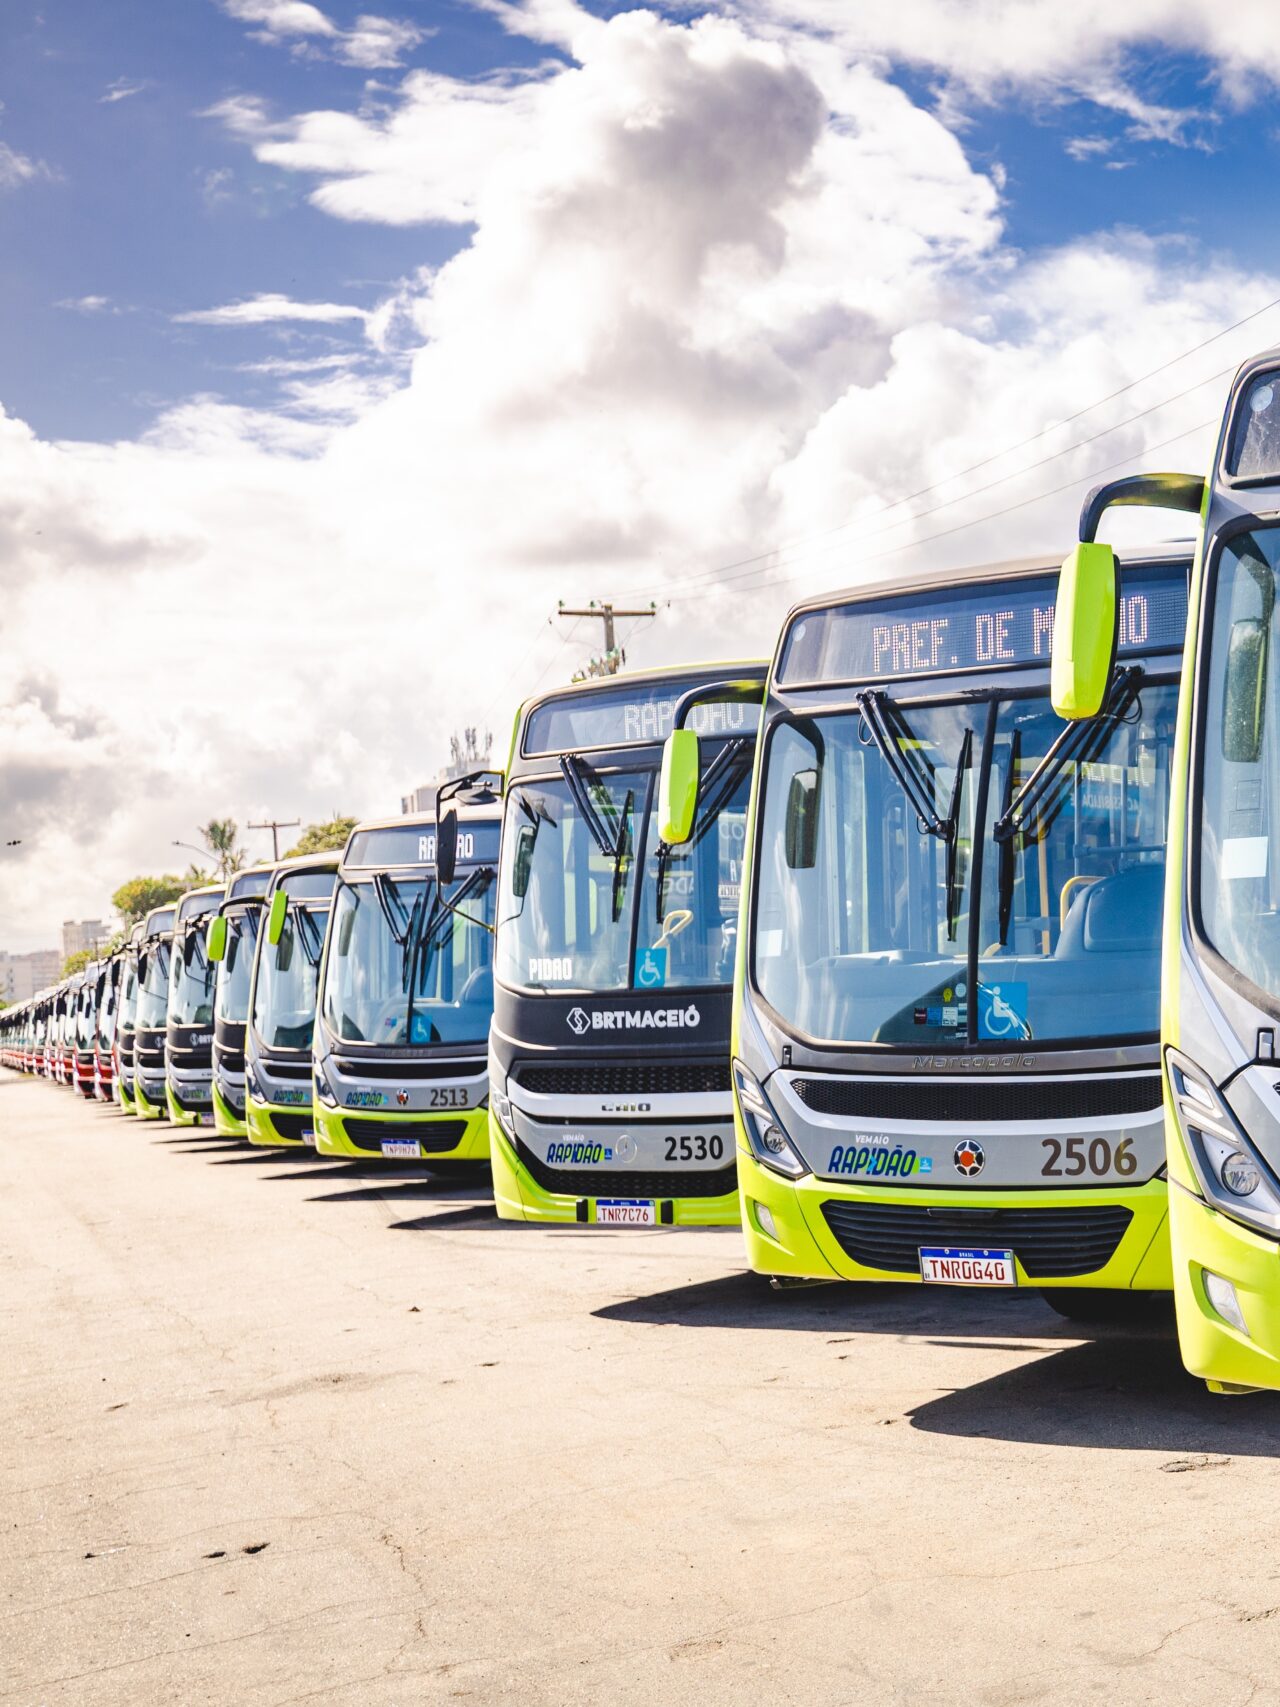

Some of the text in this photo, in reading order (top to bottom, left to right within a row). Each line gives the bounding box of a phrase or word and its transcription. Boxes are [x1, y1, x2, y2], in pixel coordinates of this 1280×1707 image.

[872, 618, 958, 673] PREF.
[975, 611, 1014, 661] DE
[418, 833, 474, 861] RAAO
[592, 1004, 701, 1030] BRTMACEIÓ
[912, 1054, 1036, 1071] Marcopolo
[430, 1088, 469, 1107] 2513
[547, 1140, 603, 1164] RAPIDÃO
[664, 1135, 724, 1162] 2530
[855, 1134, 872, 1144] VEM
[882, 1135, 890, 1145] O
[828, 1144, 917, 1177] RAPIDÃO
[1041, 1137, 1138, 1177] 2506
[601, 1207, 649, 1222] TNR7C76
